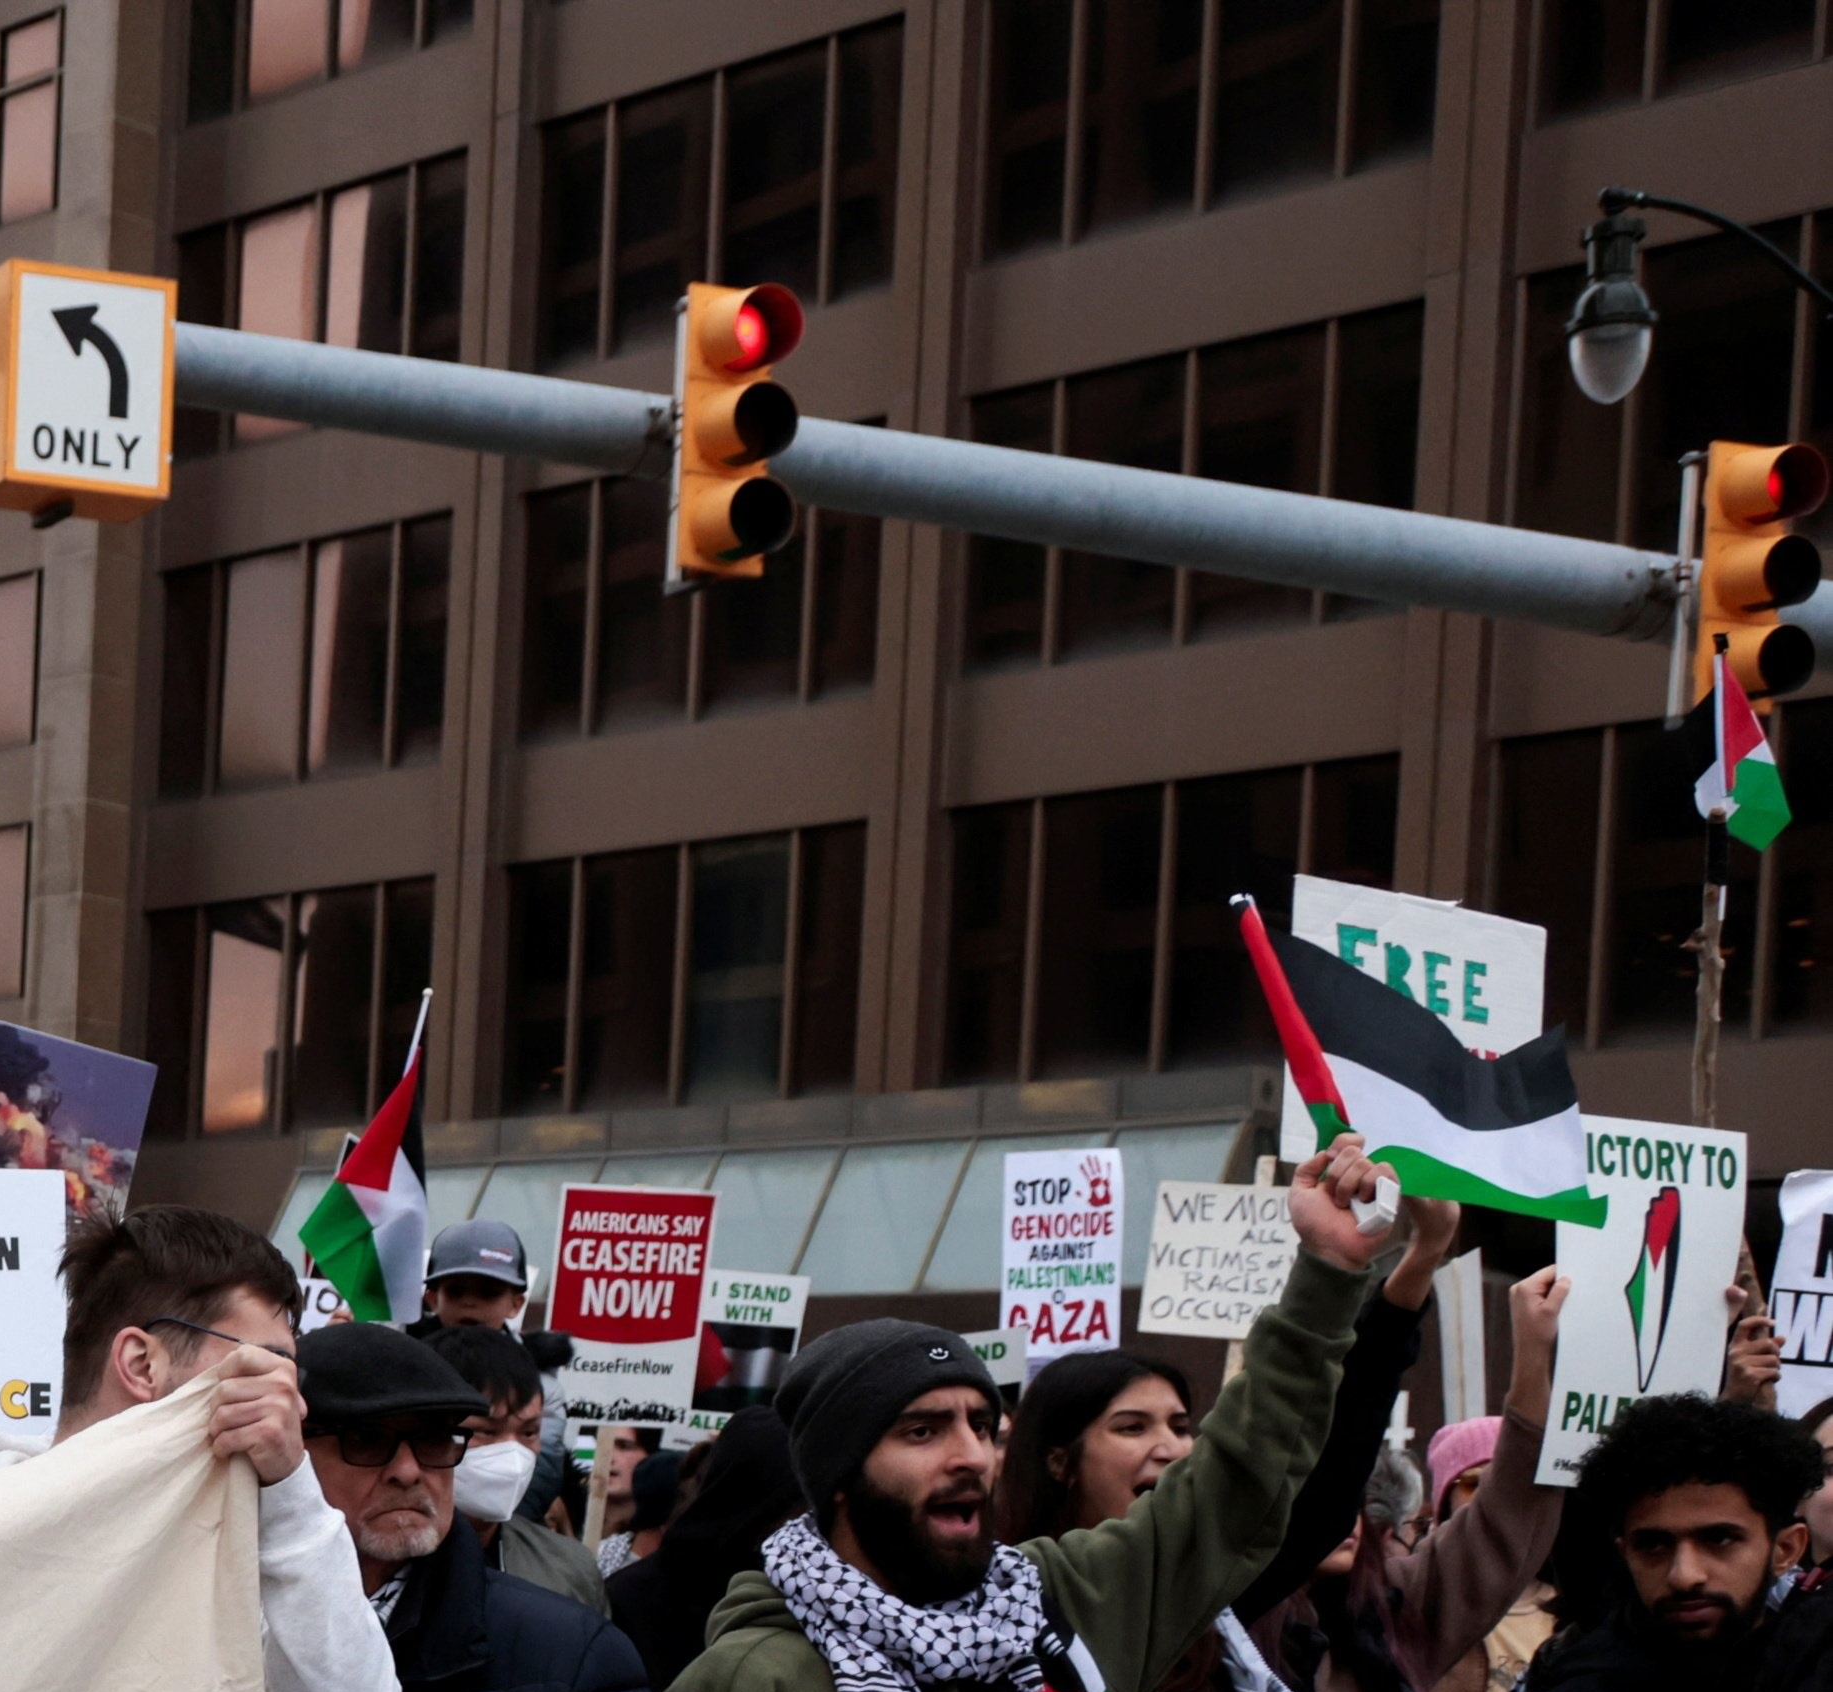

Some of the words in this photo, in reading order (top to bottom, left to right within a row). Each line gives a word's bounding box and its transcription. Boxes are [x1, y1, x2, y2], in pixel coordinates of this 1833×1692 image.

[31, 423, 141, 471] ONLY
[1336, 922, 1490, 1026] FREE
[1587, 1132, 1695, 1184] ICTORY
[1702, 1145, 1737, 1190] TO
[1014, 1178, 1071, 1206] STOP
[1163, 1192, 1218, 1223] WE
[569, 1211, 669, 1235] AMERICANS
[671, 1215, 705, 1237] SAY
[1011, 1211, 1115, 1241] GENOCIDE
[1239, 1229, 1286, 1245] ALL
[563, 1238, 703, 1276] CEASEFIRE
[1029, 1241, 1096, 1261] AGAINST
[1152, 1242, 1262, 1273] VICTIMS
[1007, 1261, 1116, 1290] PALESTINIANS
[580, 1277, 674, 1320] NOW!
[712, 1281, 718, 1296] I
[729, 1283, 791, 1302] STAND
[725, 1304, 772, 1322] WITH
[1009, 1299, 1110, 1344] GAZA
